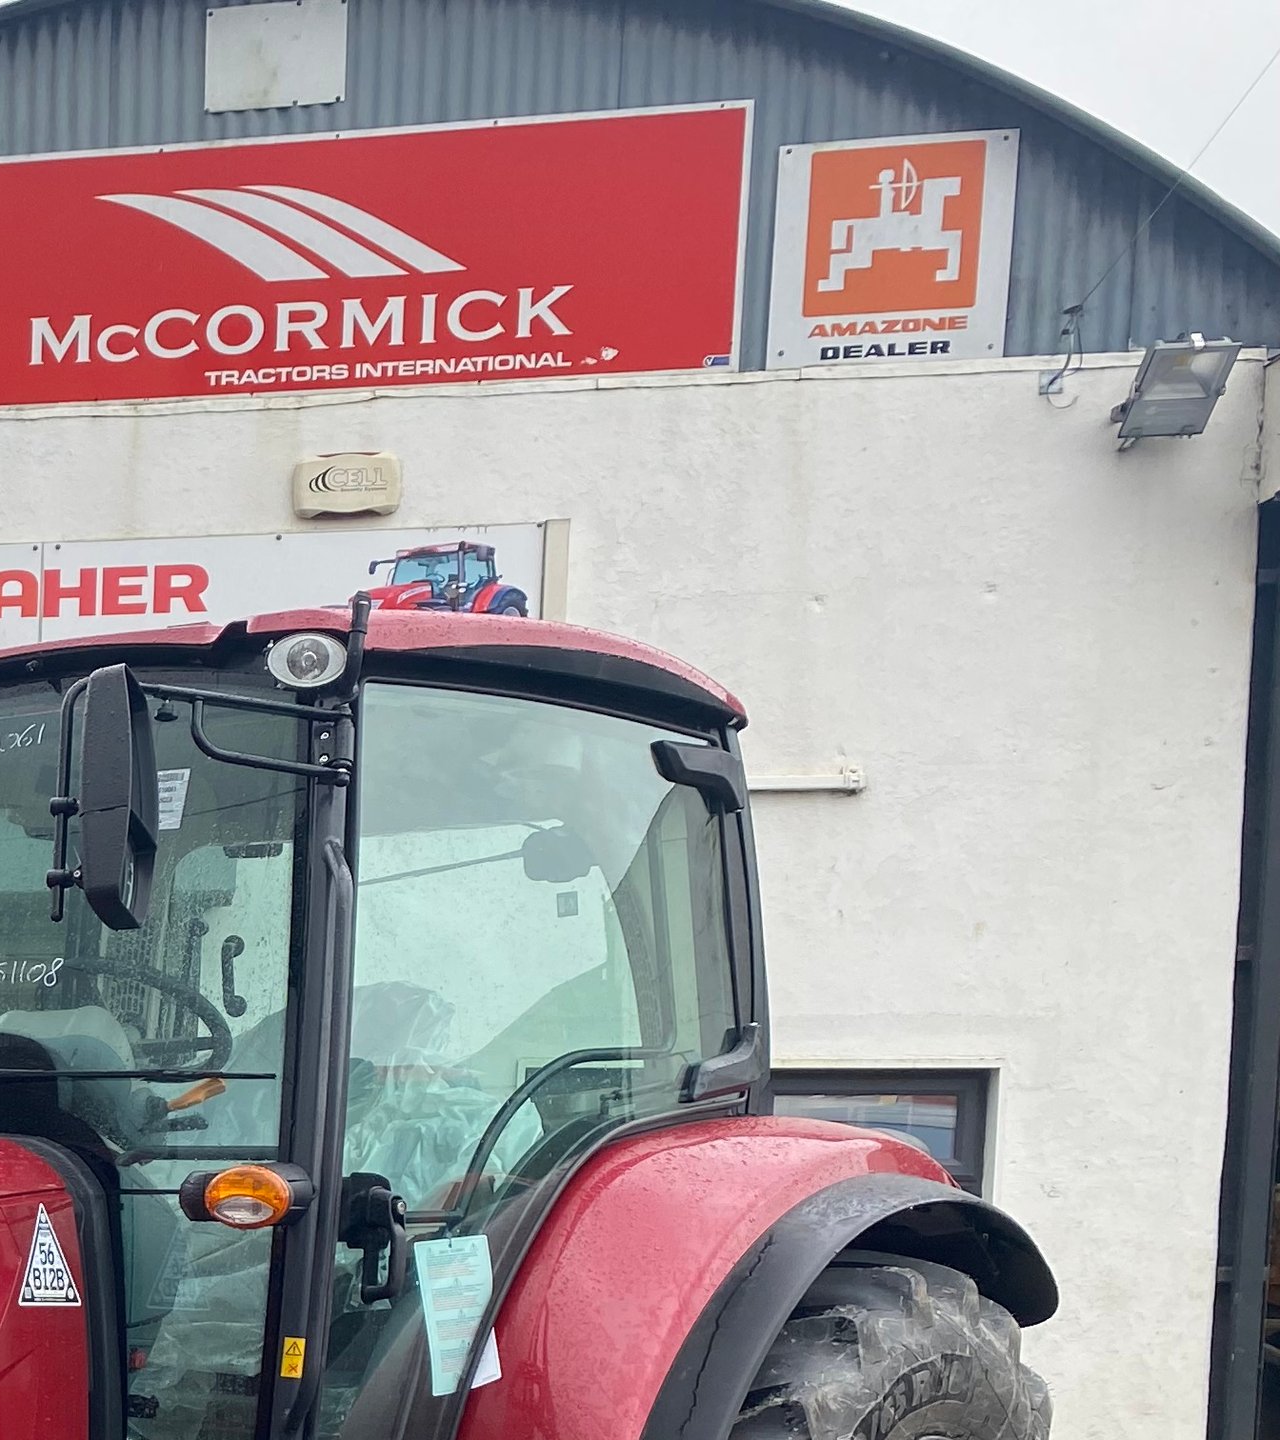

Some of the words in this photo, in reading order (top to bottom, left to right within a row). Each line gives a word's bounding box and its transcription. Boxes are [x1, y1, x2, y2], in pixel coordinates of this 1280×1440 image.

[28, 284, 576, 366] McCORMICK
[808, 315, 969, 338] AMAZONE
[820, 340, 951, 360] DEALER
[204, 363, 349, 388] TRACTORS
[354, 351, 573, 380] INTERNATIONAL
[327, 467, 388, 488] CELL
[39, 1242, 55, 1265] 56
